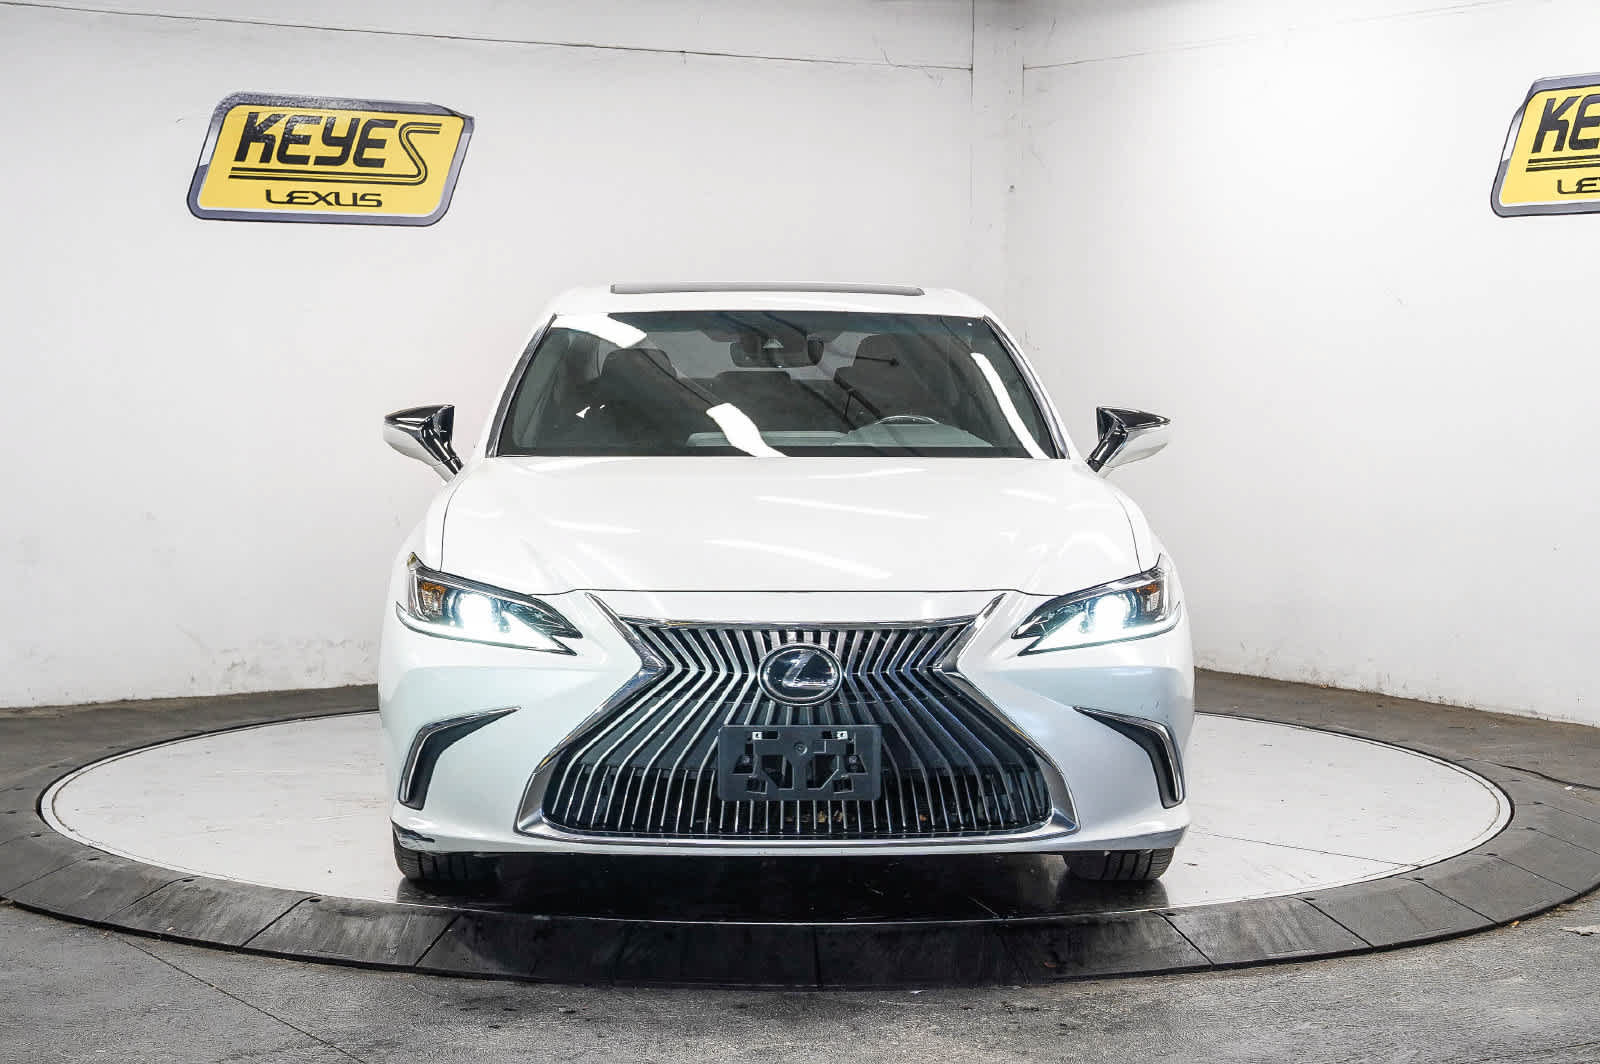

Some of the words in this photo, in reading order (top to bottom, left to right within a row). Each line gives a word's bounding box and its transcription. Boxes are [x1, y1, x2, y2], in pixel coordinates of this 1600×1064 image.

[231, 111, 443, 186] KEYES
[1557, 177, 1600, 194] LE
[265, 189, 383, 208] LEXUS
